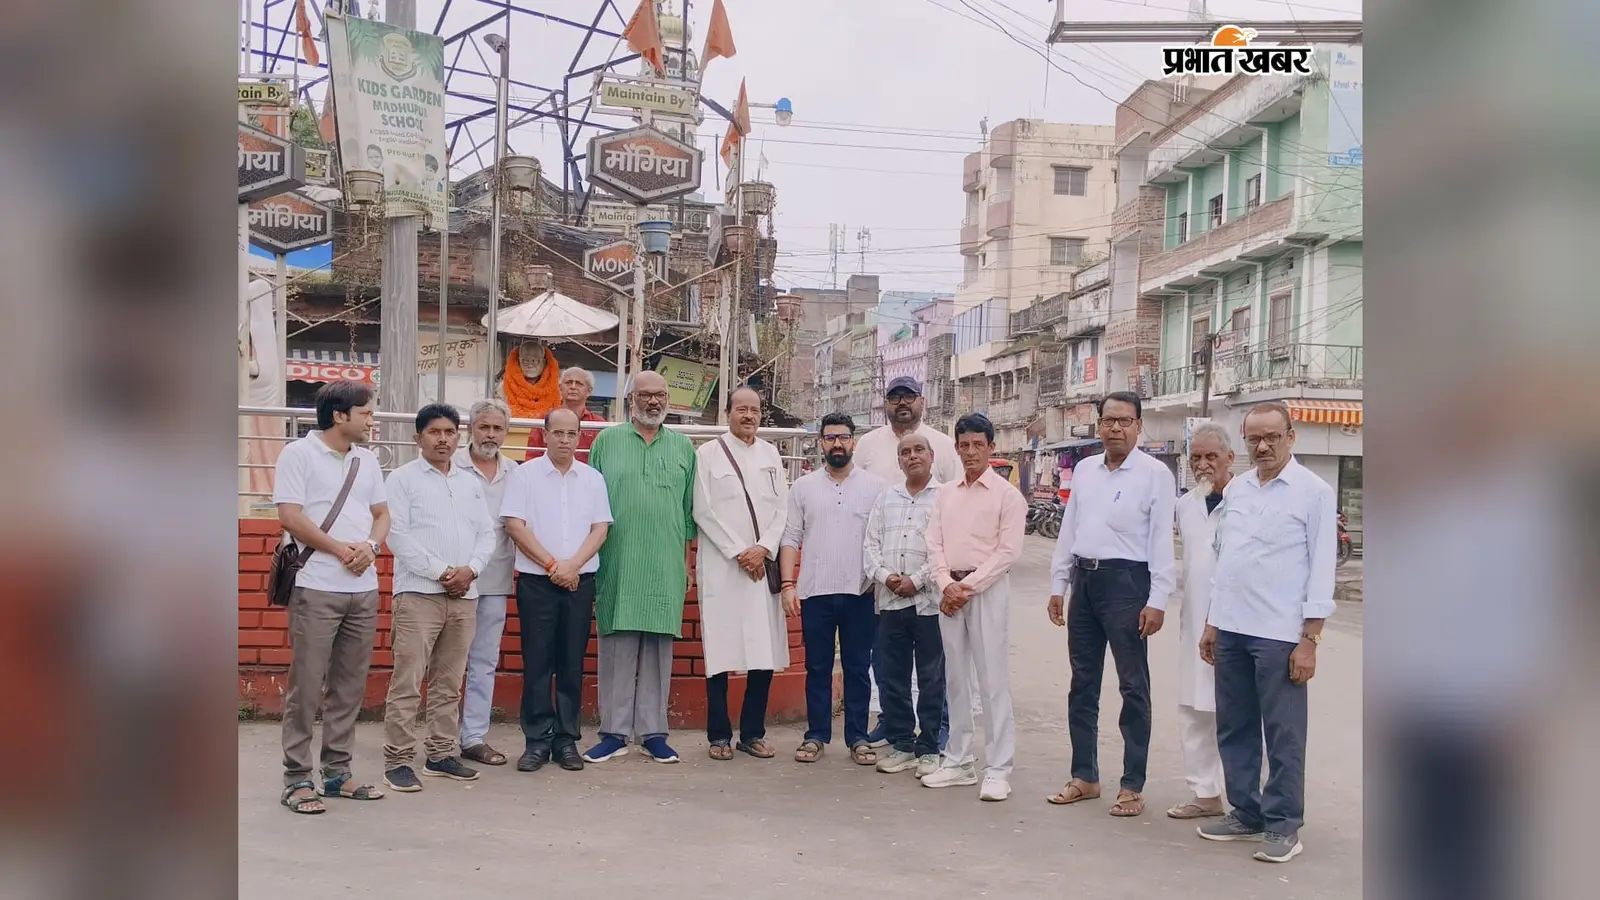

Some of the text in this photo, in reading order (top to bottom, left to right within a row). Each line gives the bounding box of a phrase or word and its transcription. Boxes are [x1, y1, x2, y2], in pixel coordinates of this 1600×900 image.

[268, 86, 283, 99] By
[357, 77, 442, 108] KIDS GARDEN
[607, 86, 685, 108] Maintain By
[372, 100, 428, 118] MADHUPUR
[605, 143, 688, 178] मोंगिया
[248, 203, 323, 232] मोंगिया
[599, 211, 636, 221] Maintai
[456, 350, 466, 368] है
[287, 364, 365, 380] DICO
